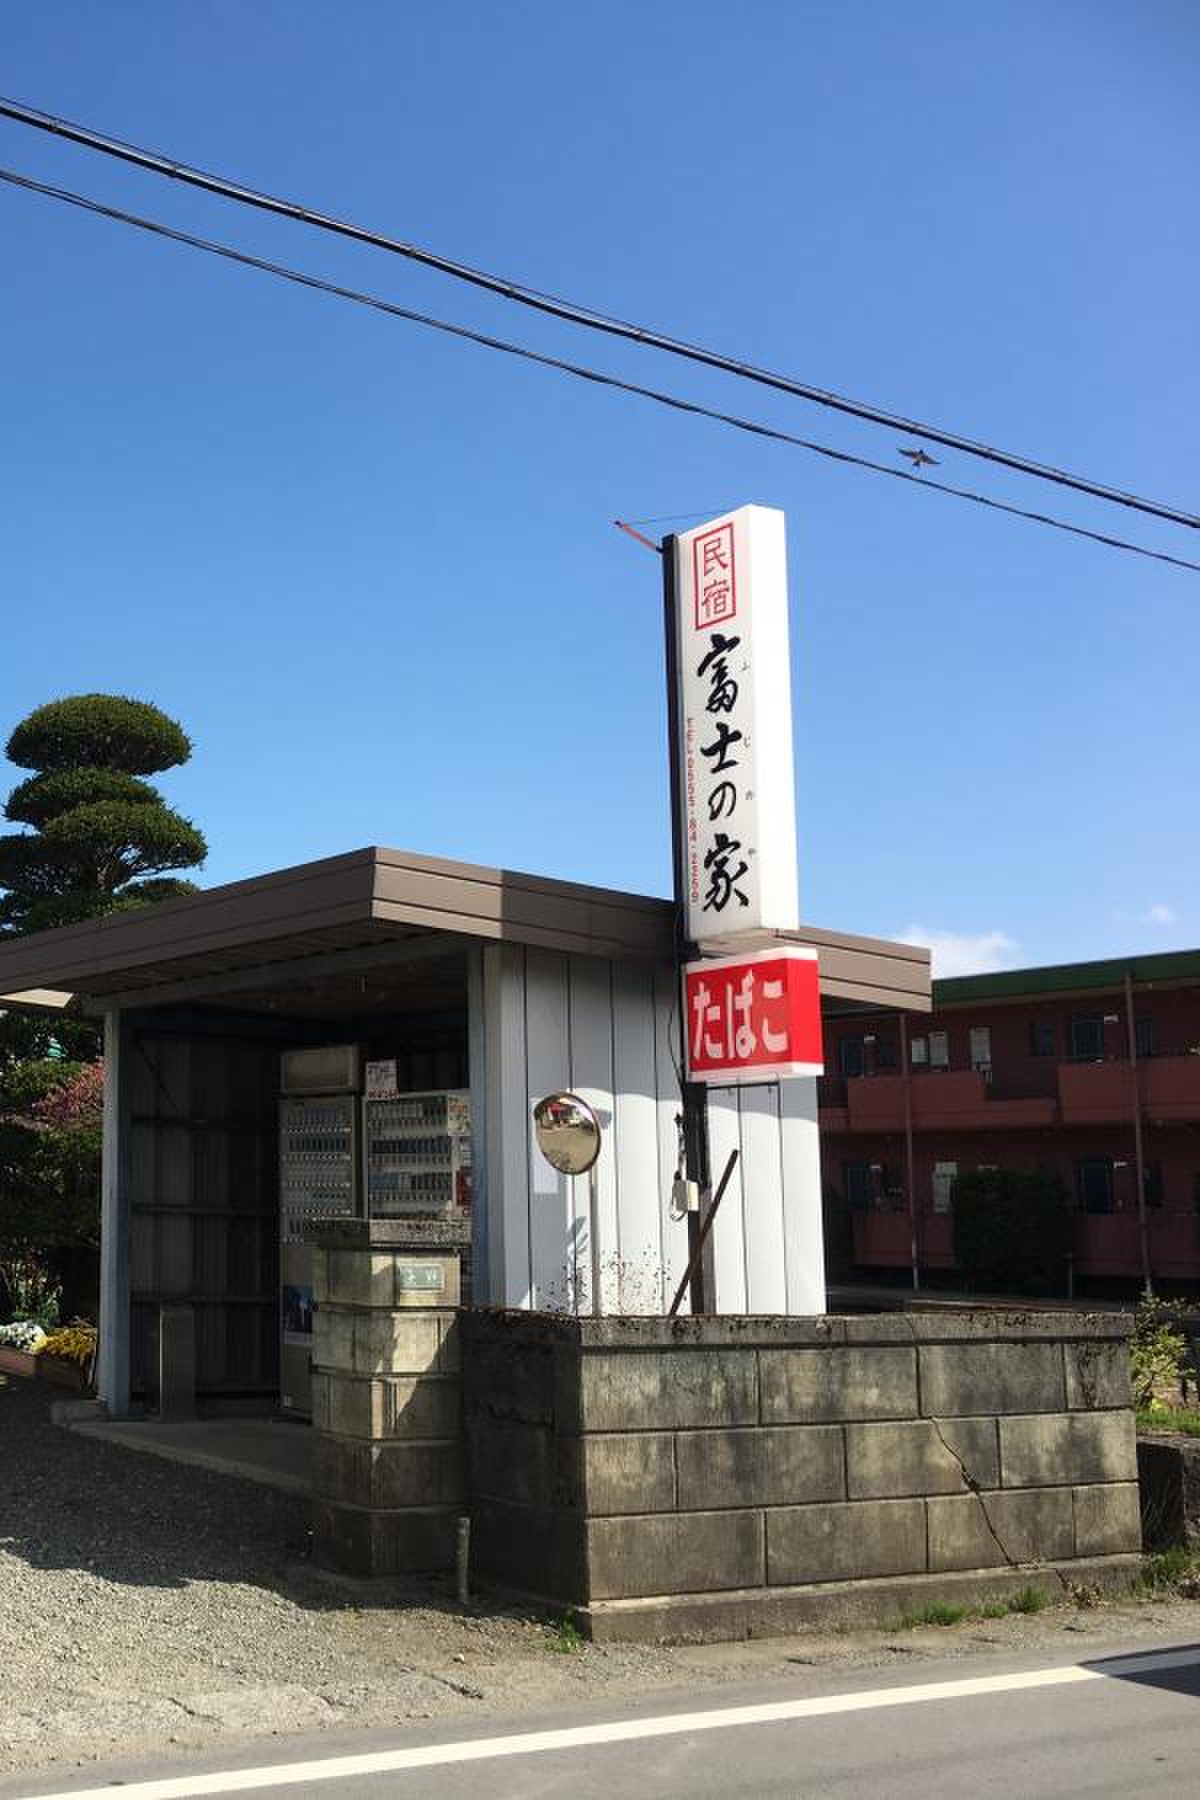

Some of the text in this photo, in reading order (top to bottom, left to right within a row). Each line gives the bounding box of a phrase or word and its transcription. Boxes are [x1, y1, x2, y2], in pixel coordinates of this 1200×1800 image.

[702, 537, 730, 618] 民宿
[697, 633, 749, 912] 富士の家
[693, 969, 789, 1059] たばこ
